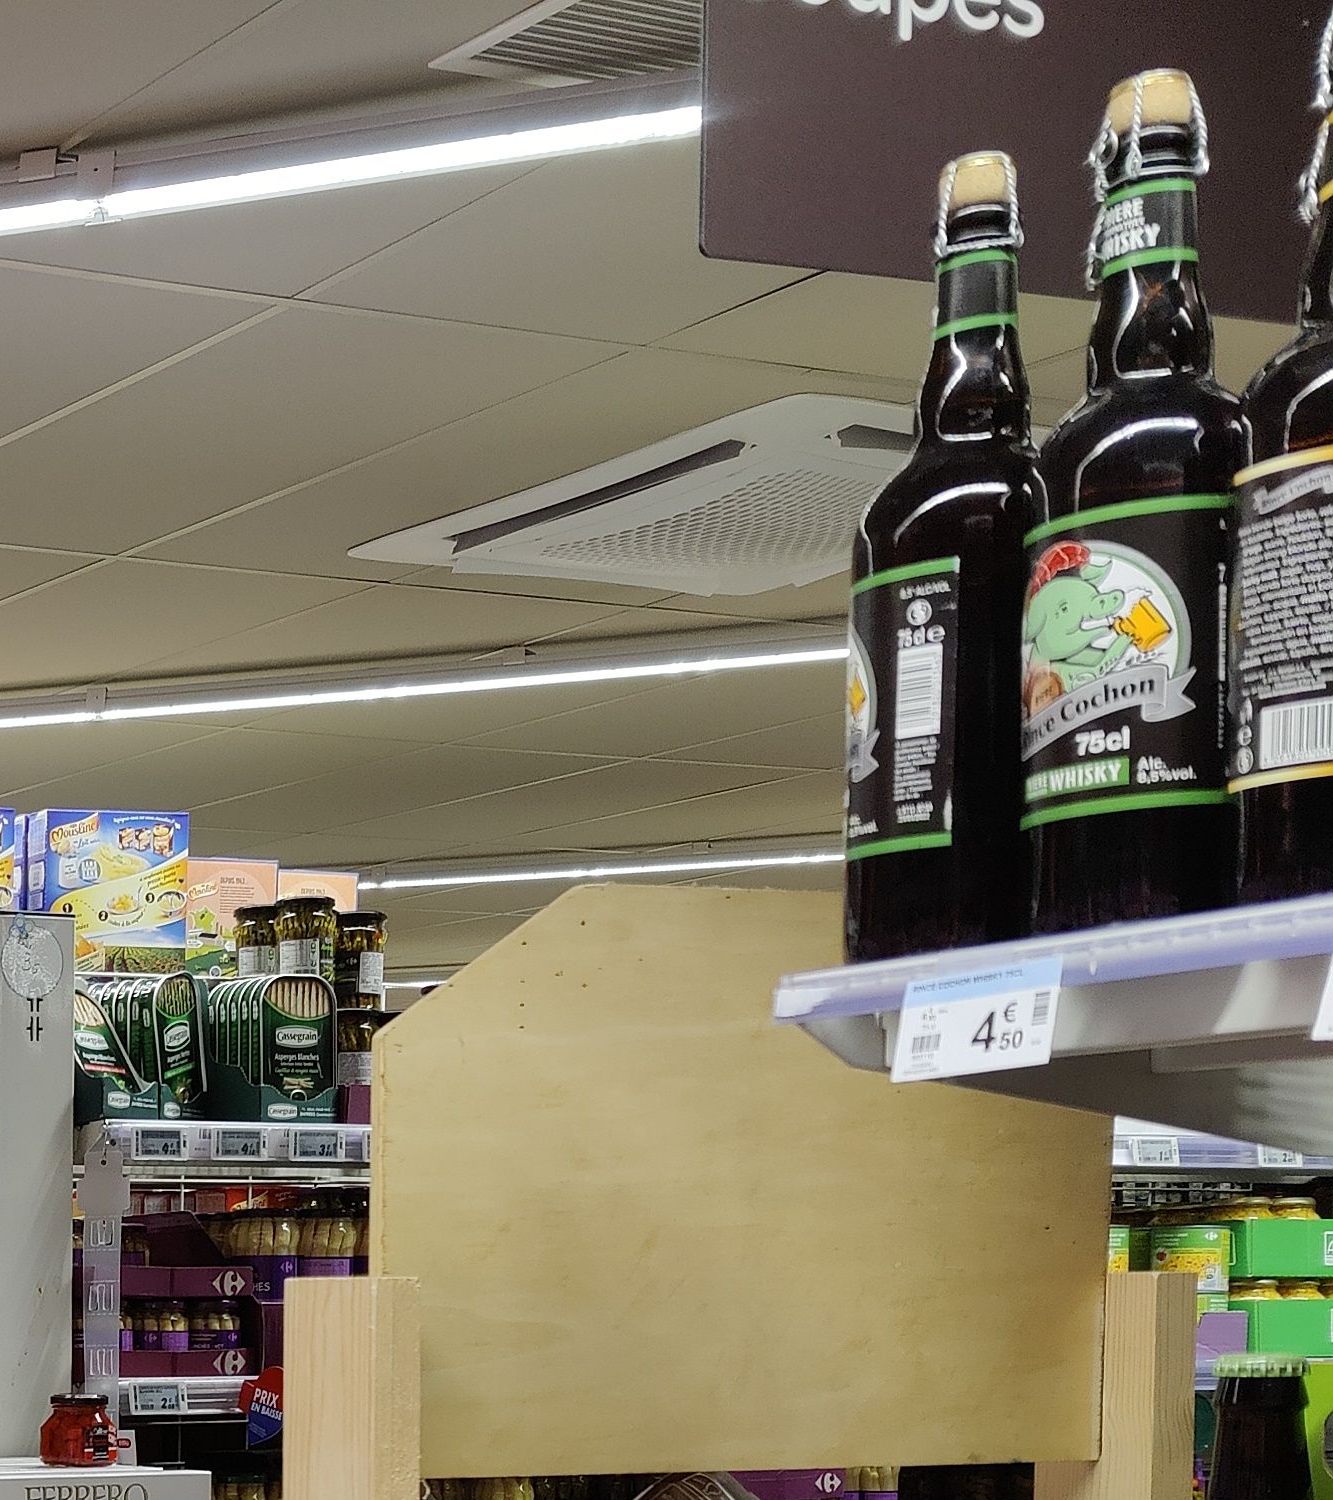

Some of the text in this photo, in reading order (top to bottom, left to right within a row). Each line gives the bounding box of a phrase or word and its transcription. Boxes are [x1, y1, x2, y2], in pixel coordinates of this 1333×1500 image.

[799, 0, 1044, 42] pes
[1060, 677, 1156, 723] Cochon
[1075, 725, 1130, 756] 75cl
[1049, 761, 1122, 792] WHISKY
[276, 1031, 318, 1043] Cassegrain
[253, 1387, 280, 1409] PRIX
[261, 1405, 283, 1422] BAISSE
